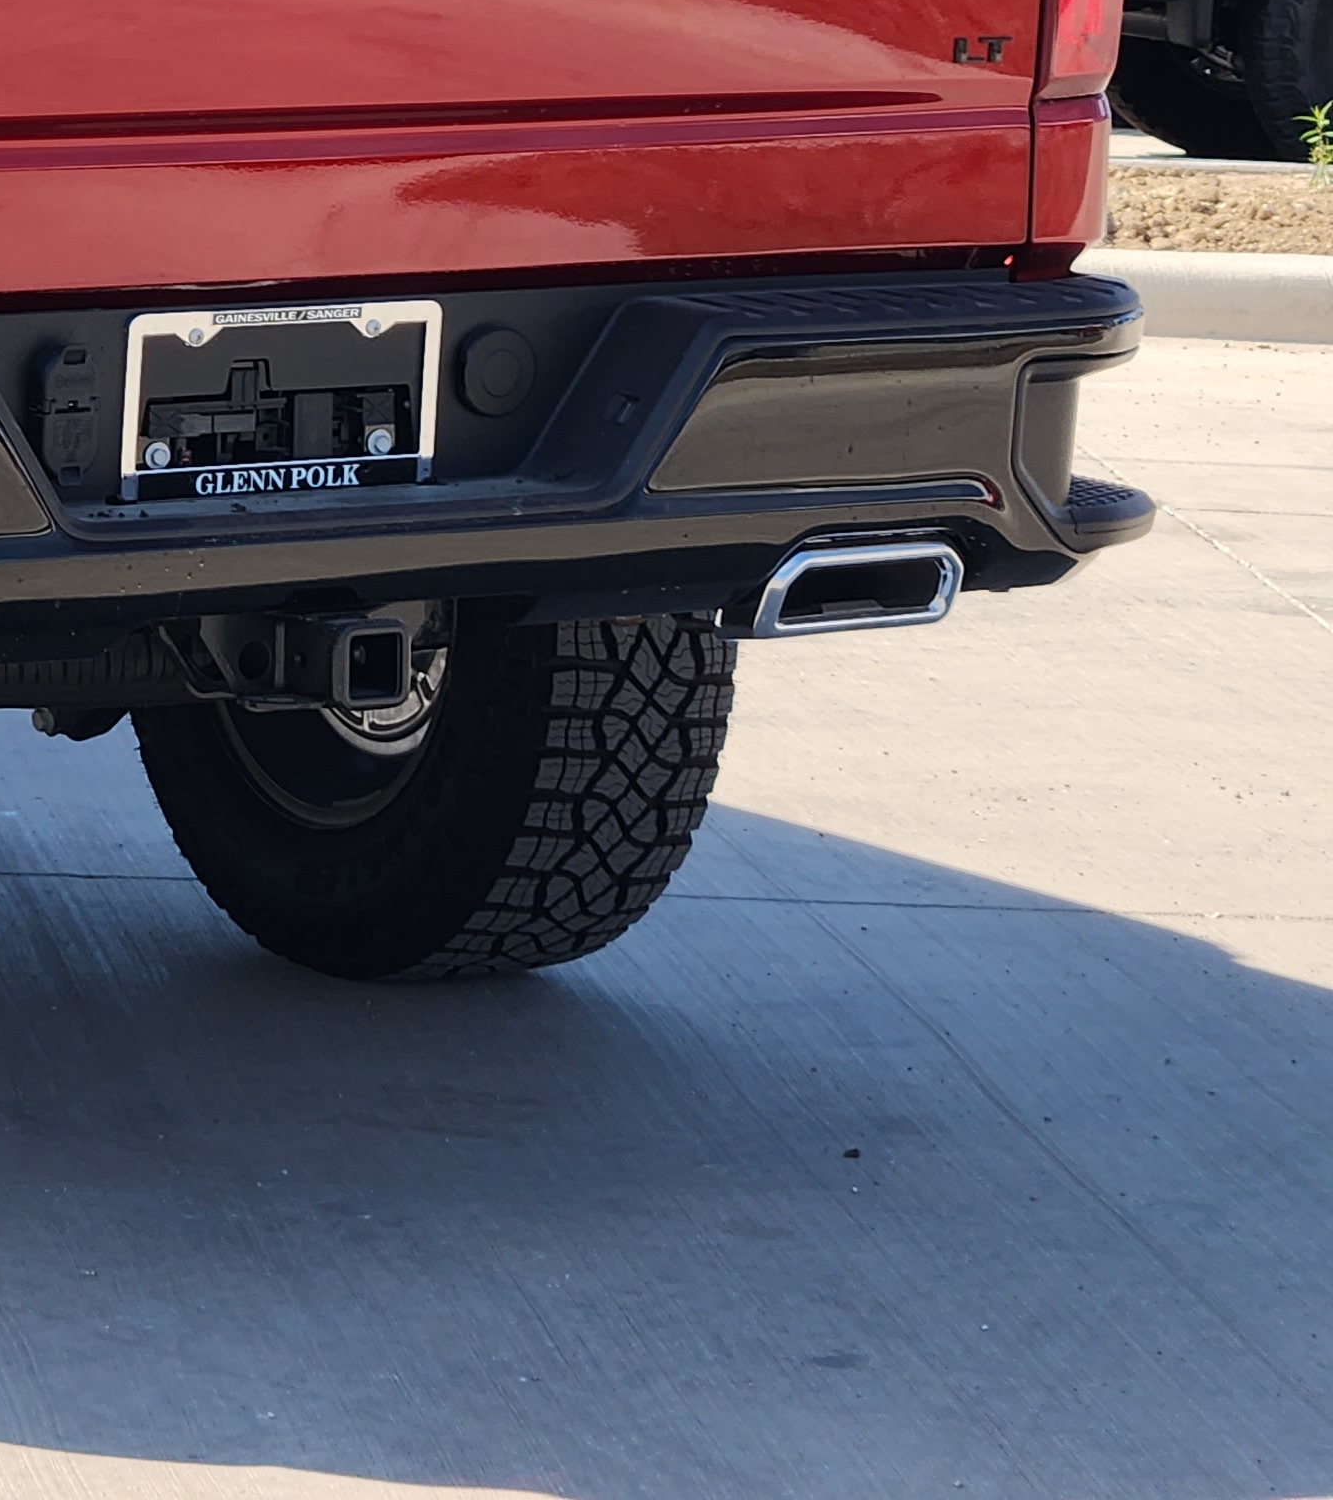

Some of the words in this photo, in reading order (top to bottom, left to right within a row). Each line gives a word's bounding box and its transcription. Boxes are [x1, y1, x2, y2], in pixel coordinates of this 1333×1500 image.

[953, 36, 1013, 63] LT
[194, 469, 284, 495] GLENN
[290, 463, 361, 488] POLK
